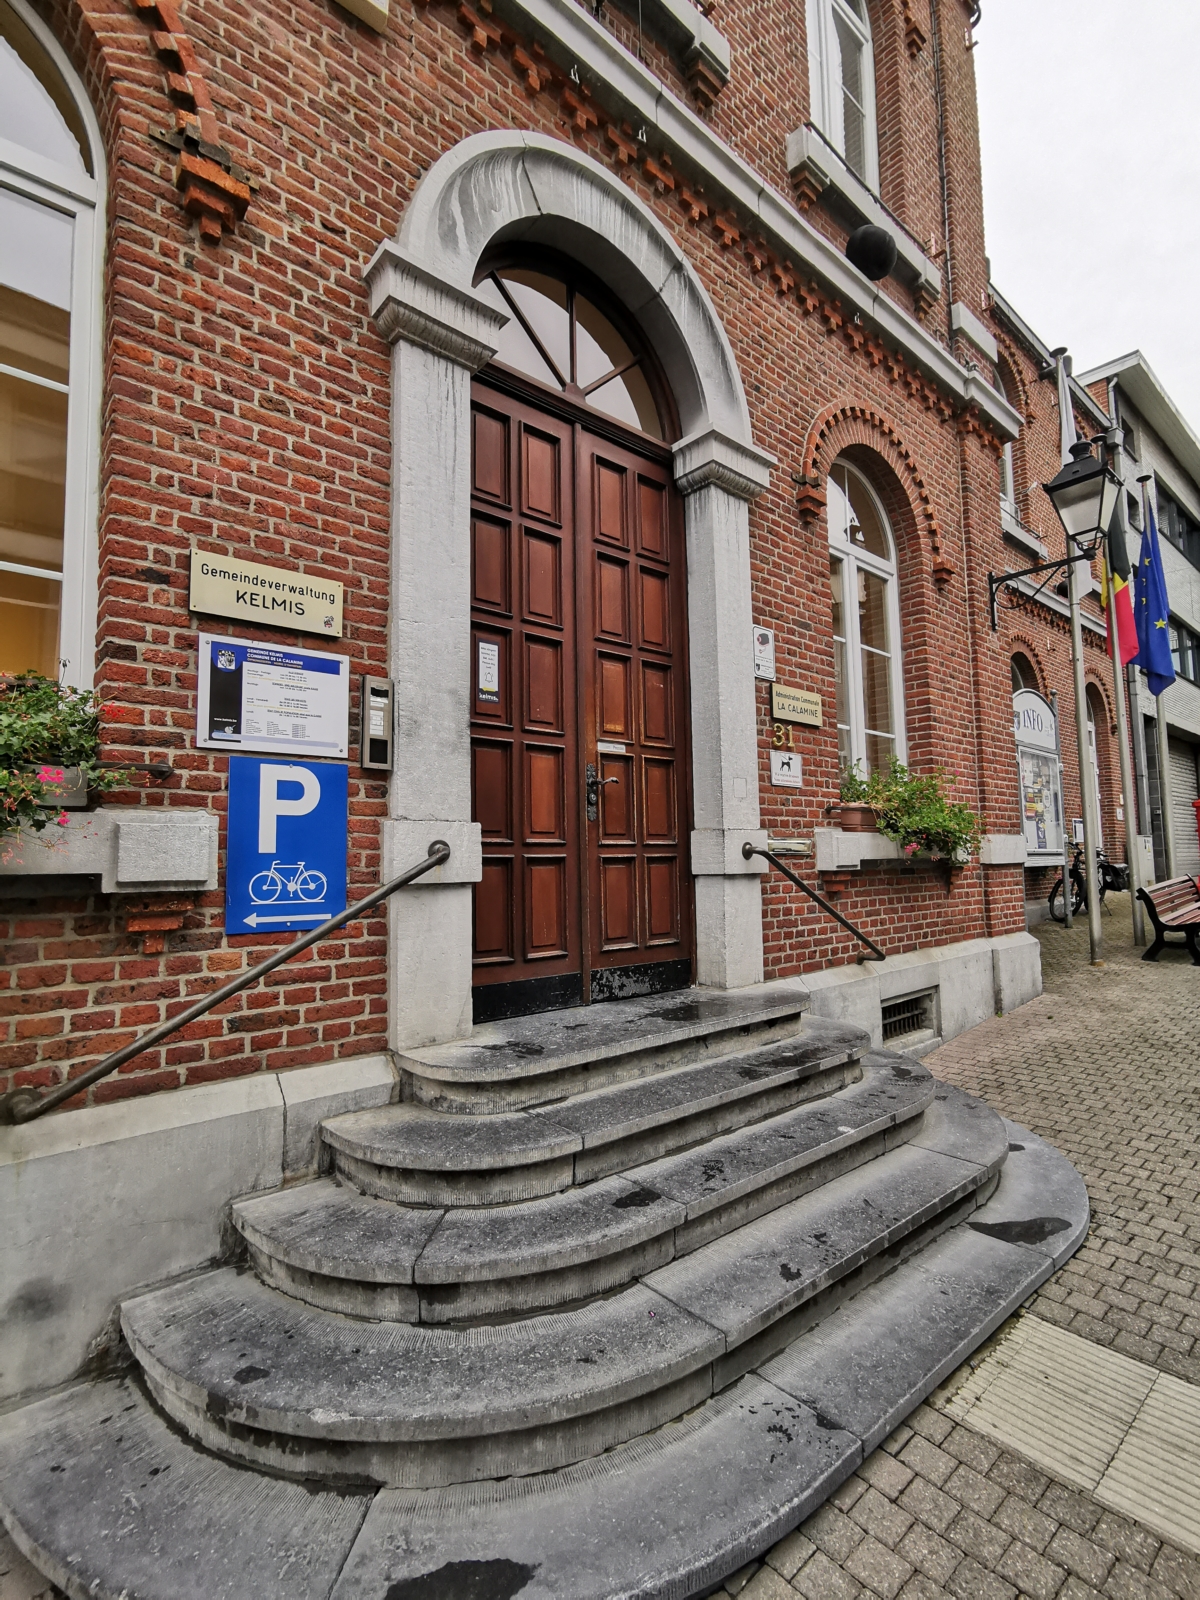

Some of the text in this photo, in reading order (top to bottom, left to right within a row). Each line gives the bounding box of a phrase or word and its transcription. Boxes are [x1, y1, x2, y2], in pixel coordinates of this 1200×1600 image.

[201, 563, 335, 604] Gemeindeverwaltung
[236, 589, 305, 616] KELMIS
[777, 702, 818, 718] LA CALAMINE
[1023, 708, 1043, 732] INFO
[772, 723, 795, 747] 31
[258, 763, 321, 854] P
